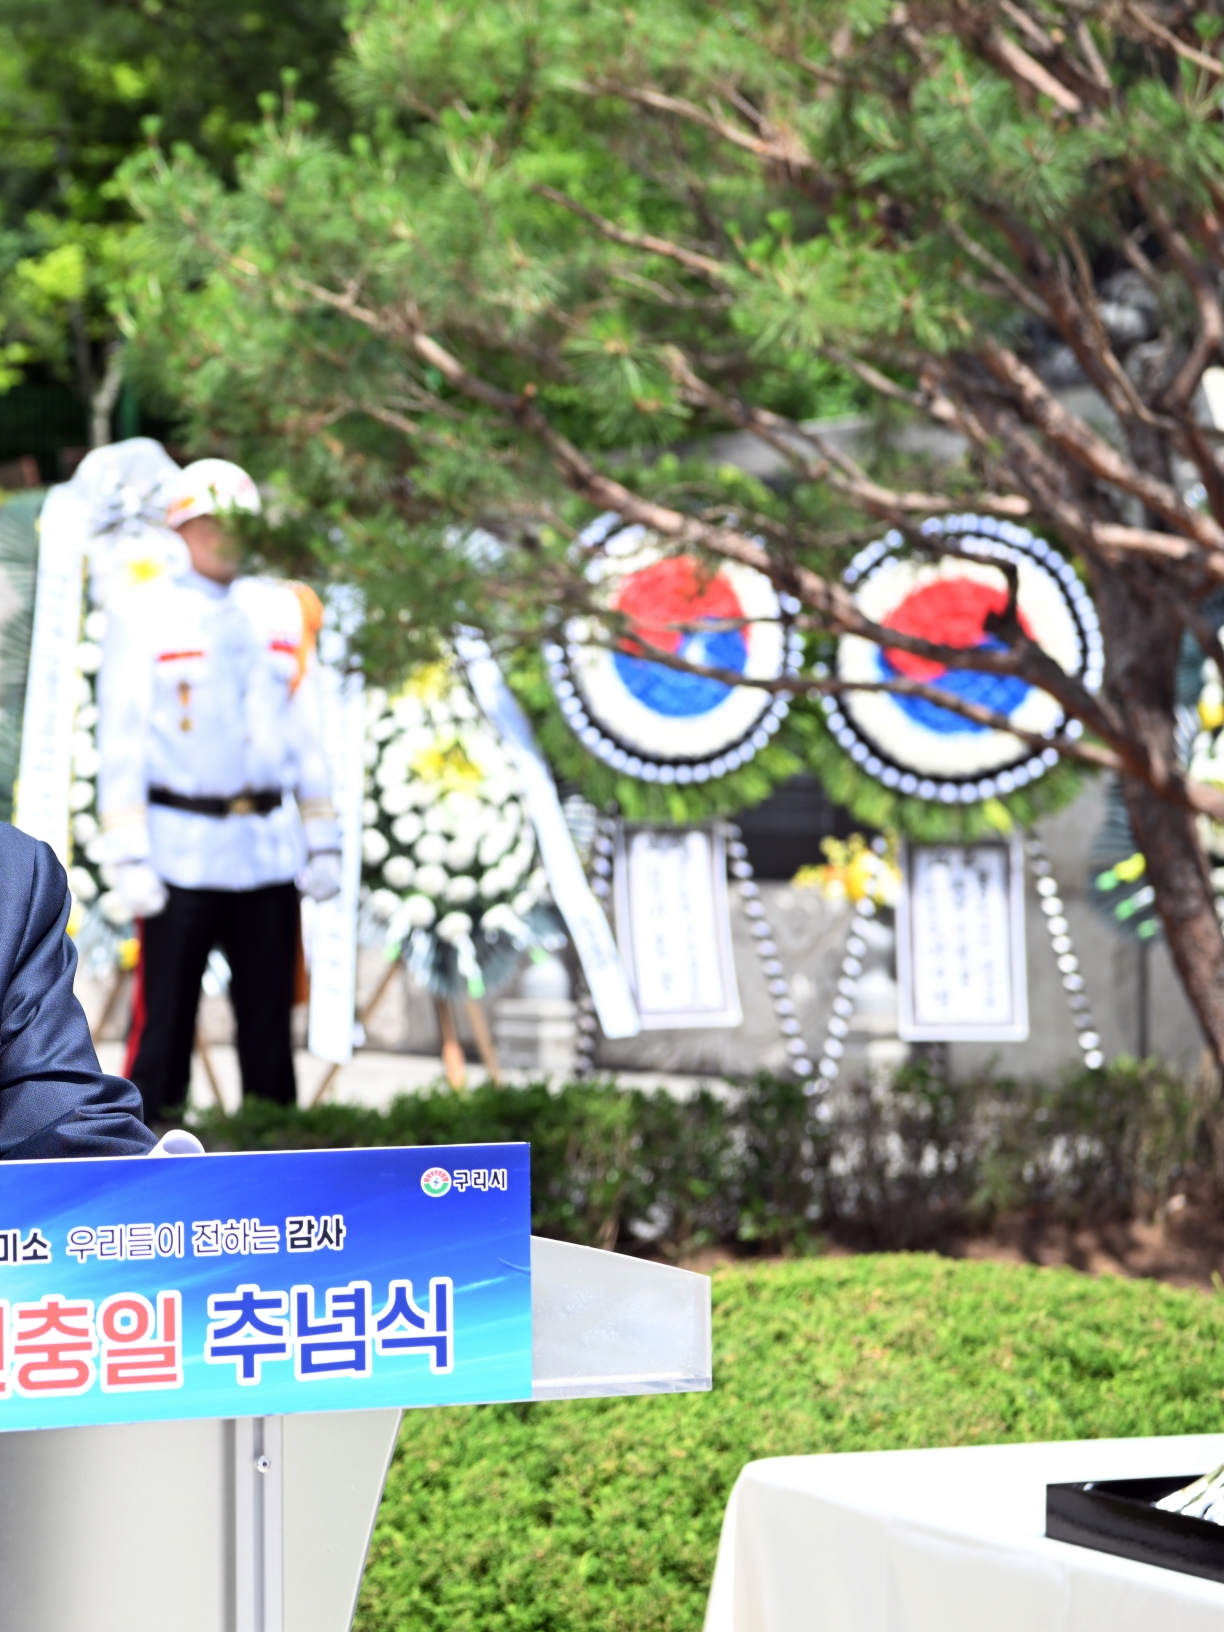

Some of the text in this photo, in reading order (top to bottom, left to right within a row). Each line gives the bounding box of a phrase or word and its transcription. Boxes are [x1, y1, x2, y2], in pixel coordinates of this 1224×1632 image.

[453, 1169, 508, 1192] 구리시
[67, 1223, 183, 1260] 우리들이
[192, 1220, 278, 1255] 전하는
[287, 1216, 344, 1251] 감사
[210, 1283, 448, 1380] 추념식
